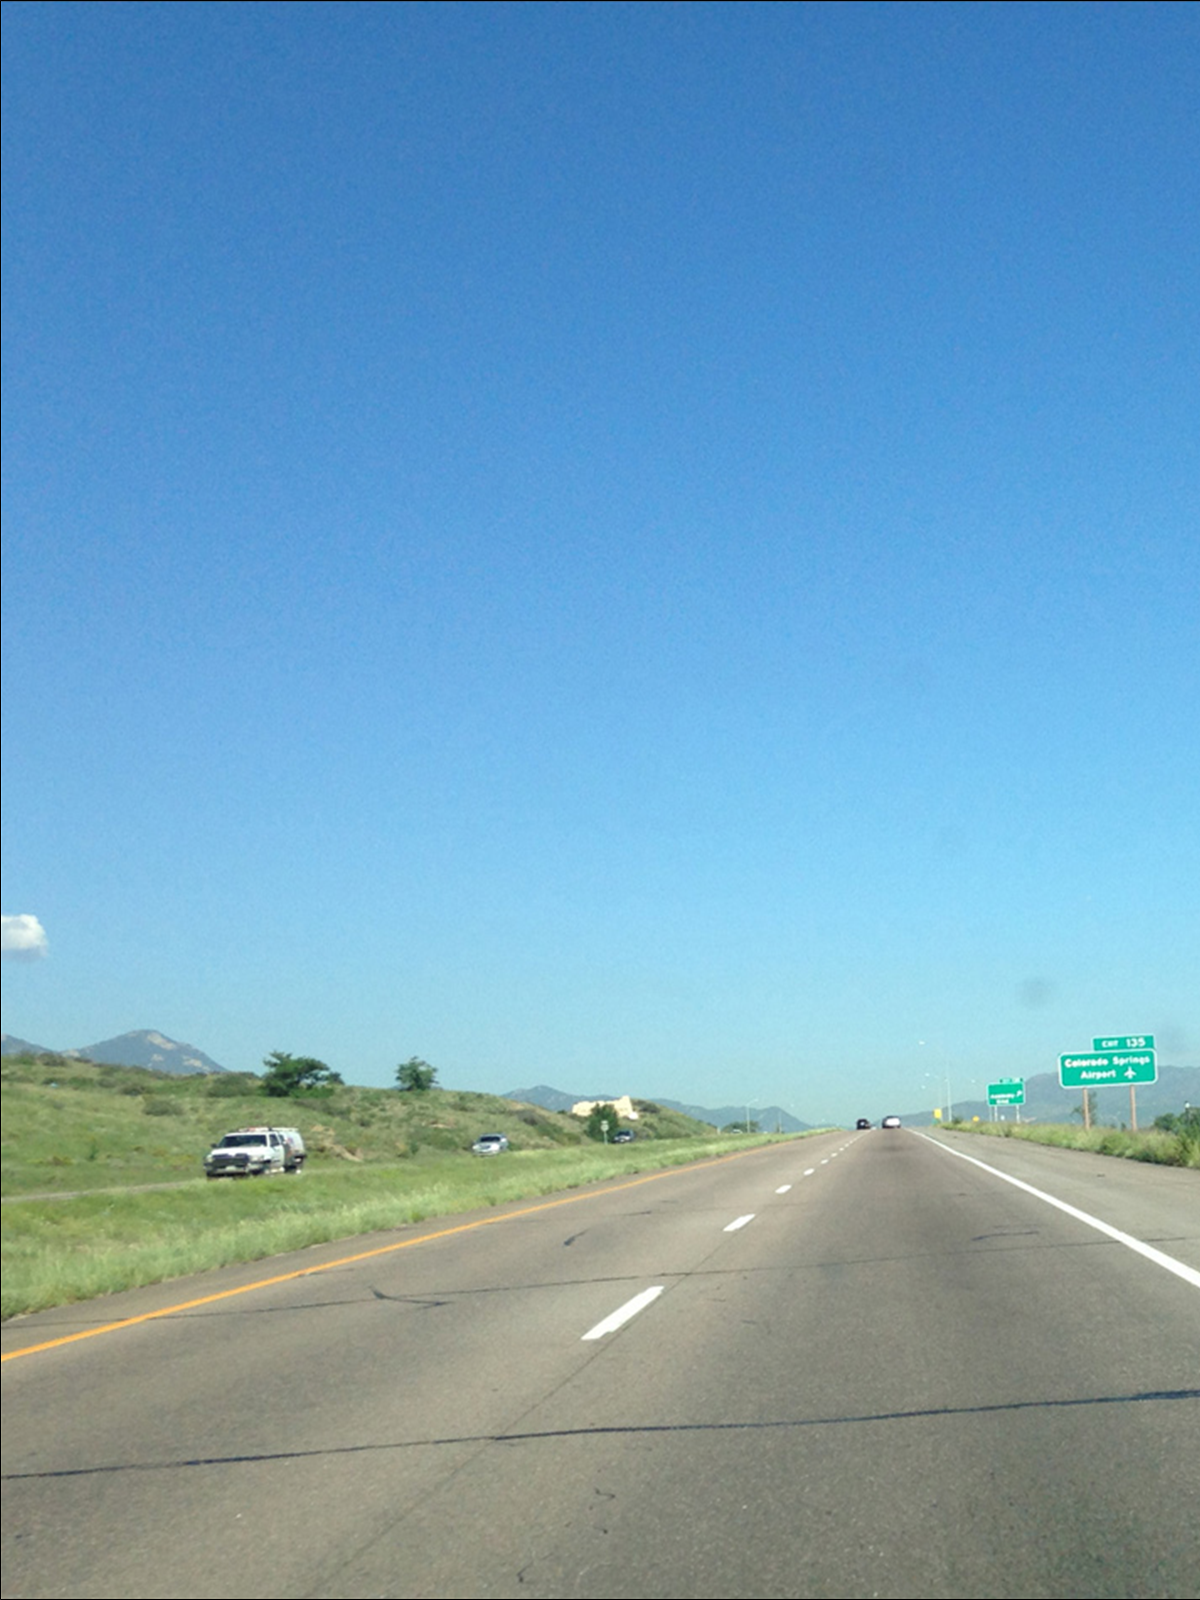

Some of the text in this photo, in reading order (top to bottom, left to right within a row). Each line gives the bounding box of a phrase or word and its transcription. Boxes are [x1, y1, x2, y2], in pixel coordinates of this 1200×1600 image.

[1126, 1037, 1146, 1048] 135
[1064, 1055, 1151, 1068] Colorado Springs
[1080, 1069, 1117, 1080] Airport
